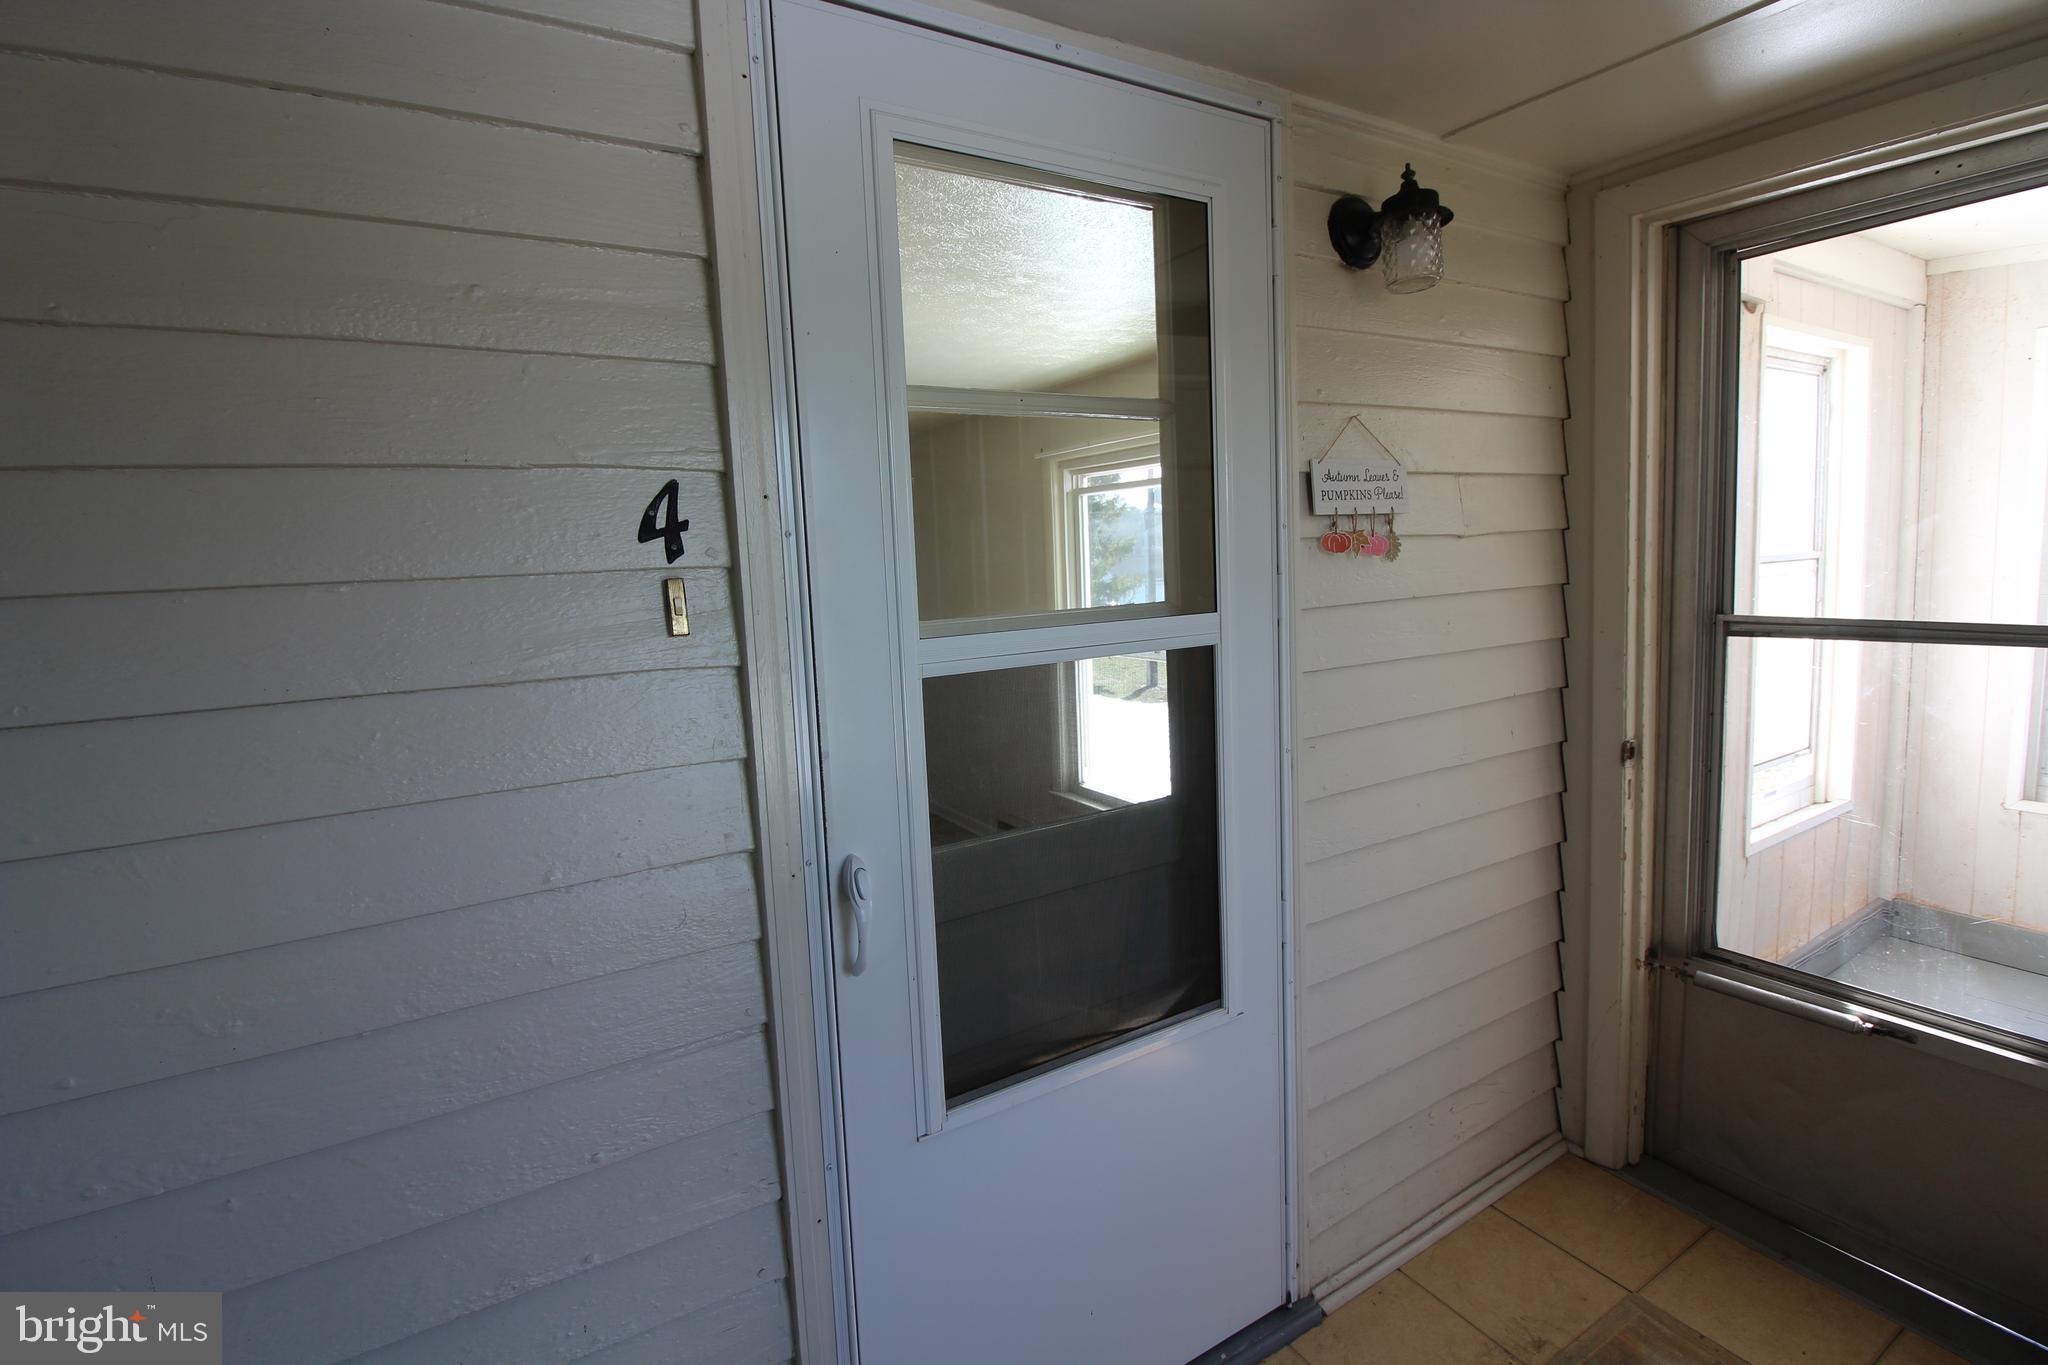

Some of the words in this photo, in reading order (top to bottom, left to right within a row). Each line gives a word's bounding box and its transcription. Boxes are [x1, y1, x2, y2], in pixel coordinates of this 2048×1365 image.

[1321, 468, 1360, 483] Autumn
[1363, 468, 1390, 482] Leaves
[1392, 469, 1400, 482] &
[1321, 489, 1372, 501] PUMPKINS
[1373, 485, 1404, 500] Please!
[637, 478, 690, 564] 4
